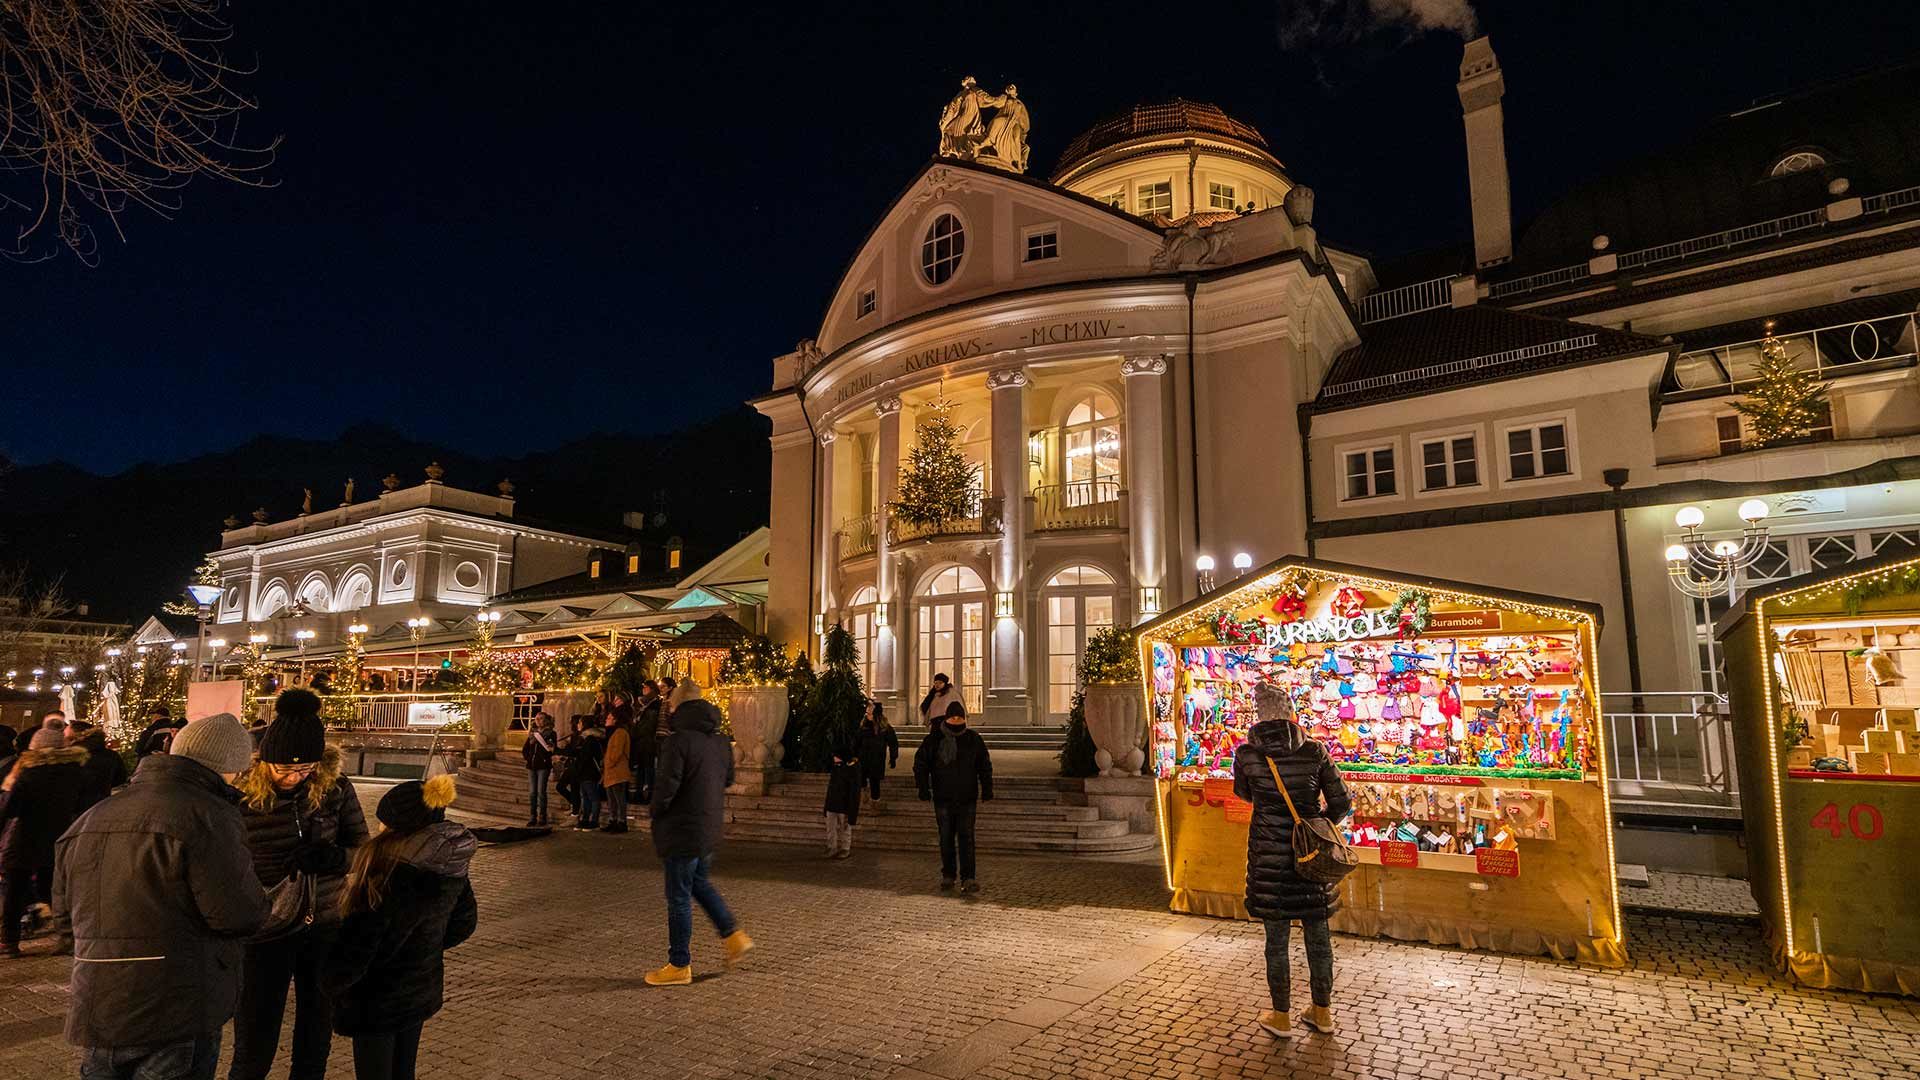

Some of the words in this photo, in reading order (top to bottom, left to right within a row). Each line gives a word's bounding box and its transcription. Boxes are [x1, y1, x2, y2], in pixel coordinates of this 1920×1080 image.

[905, 337, 981, 371] KVRHAVS
[1032, 320, 1111, 344] MCMXIV
[1265, 610, 1400, 648] BURAMBOLE
[1431, 617, 1483, 627] Burambole
[1809, 802, 1884, 840] 40
